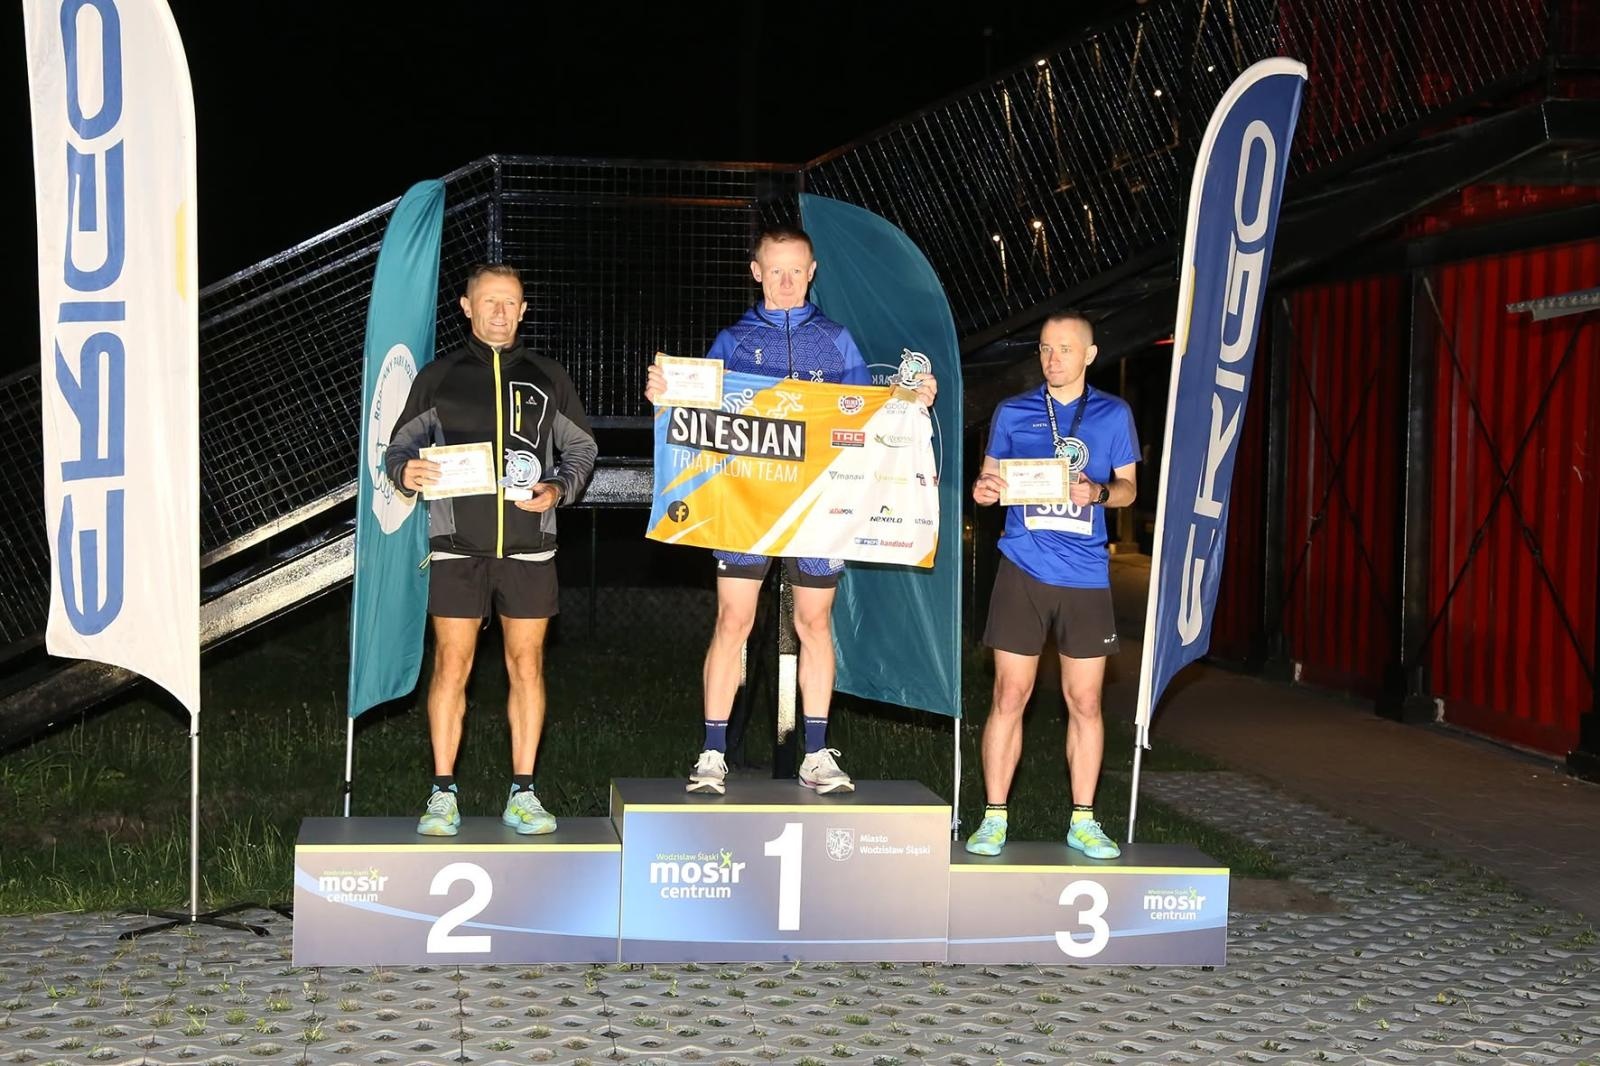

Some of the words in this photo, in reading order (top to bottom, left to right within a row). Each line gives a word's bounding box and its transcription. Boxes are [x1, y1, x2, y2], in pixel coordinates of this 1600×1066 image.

[672, 408, 802, 458] SILESIAN
[672, 448, 751, 478] TRIATHLON
[758, 462, 798, 482] TEAM
[860, 834, 888, 843] Miasto
[650, 862, 746, 884] mosir
[764, 822, 803, 931] 1
[319, 875, 389, 892] mosir
[660, 884, 731, 899] centrum
[326, 892, 379, 903] centrum
[1143, 895, 1206, 910] mosir
[426, 862, 494, 954] 2
[1150, 911, 1197, 920] centrum
[1055, 880, 1110, 958] 3
